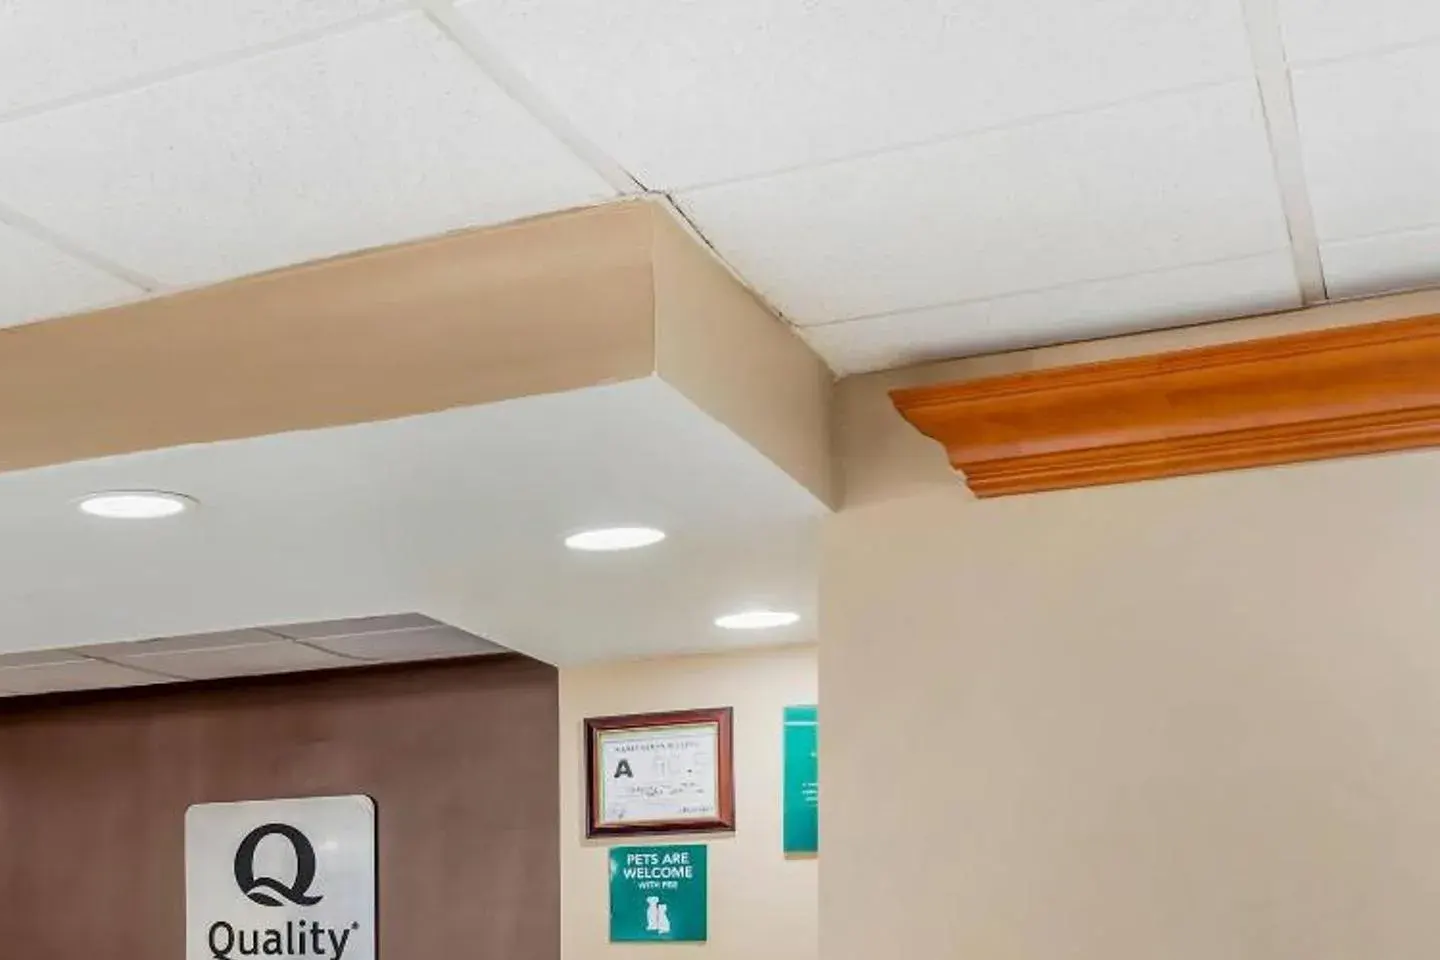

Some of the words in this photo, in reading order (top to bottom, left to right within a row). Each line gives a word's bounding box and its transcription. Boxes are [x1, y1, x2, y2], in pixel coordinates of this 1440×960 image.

[613, 758, 634, 778] A
[233, 823, 324, 907] Q
[626, 853, 659, 866] PETS
[662, 852, 690, 865] ARE
[623, 866, 693, 879] WELCOME
